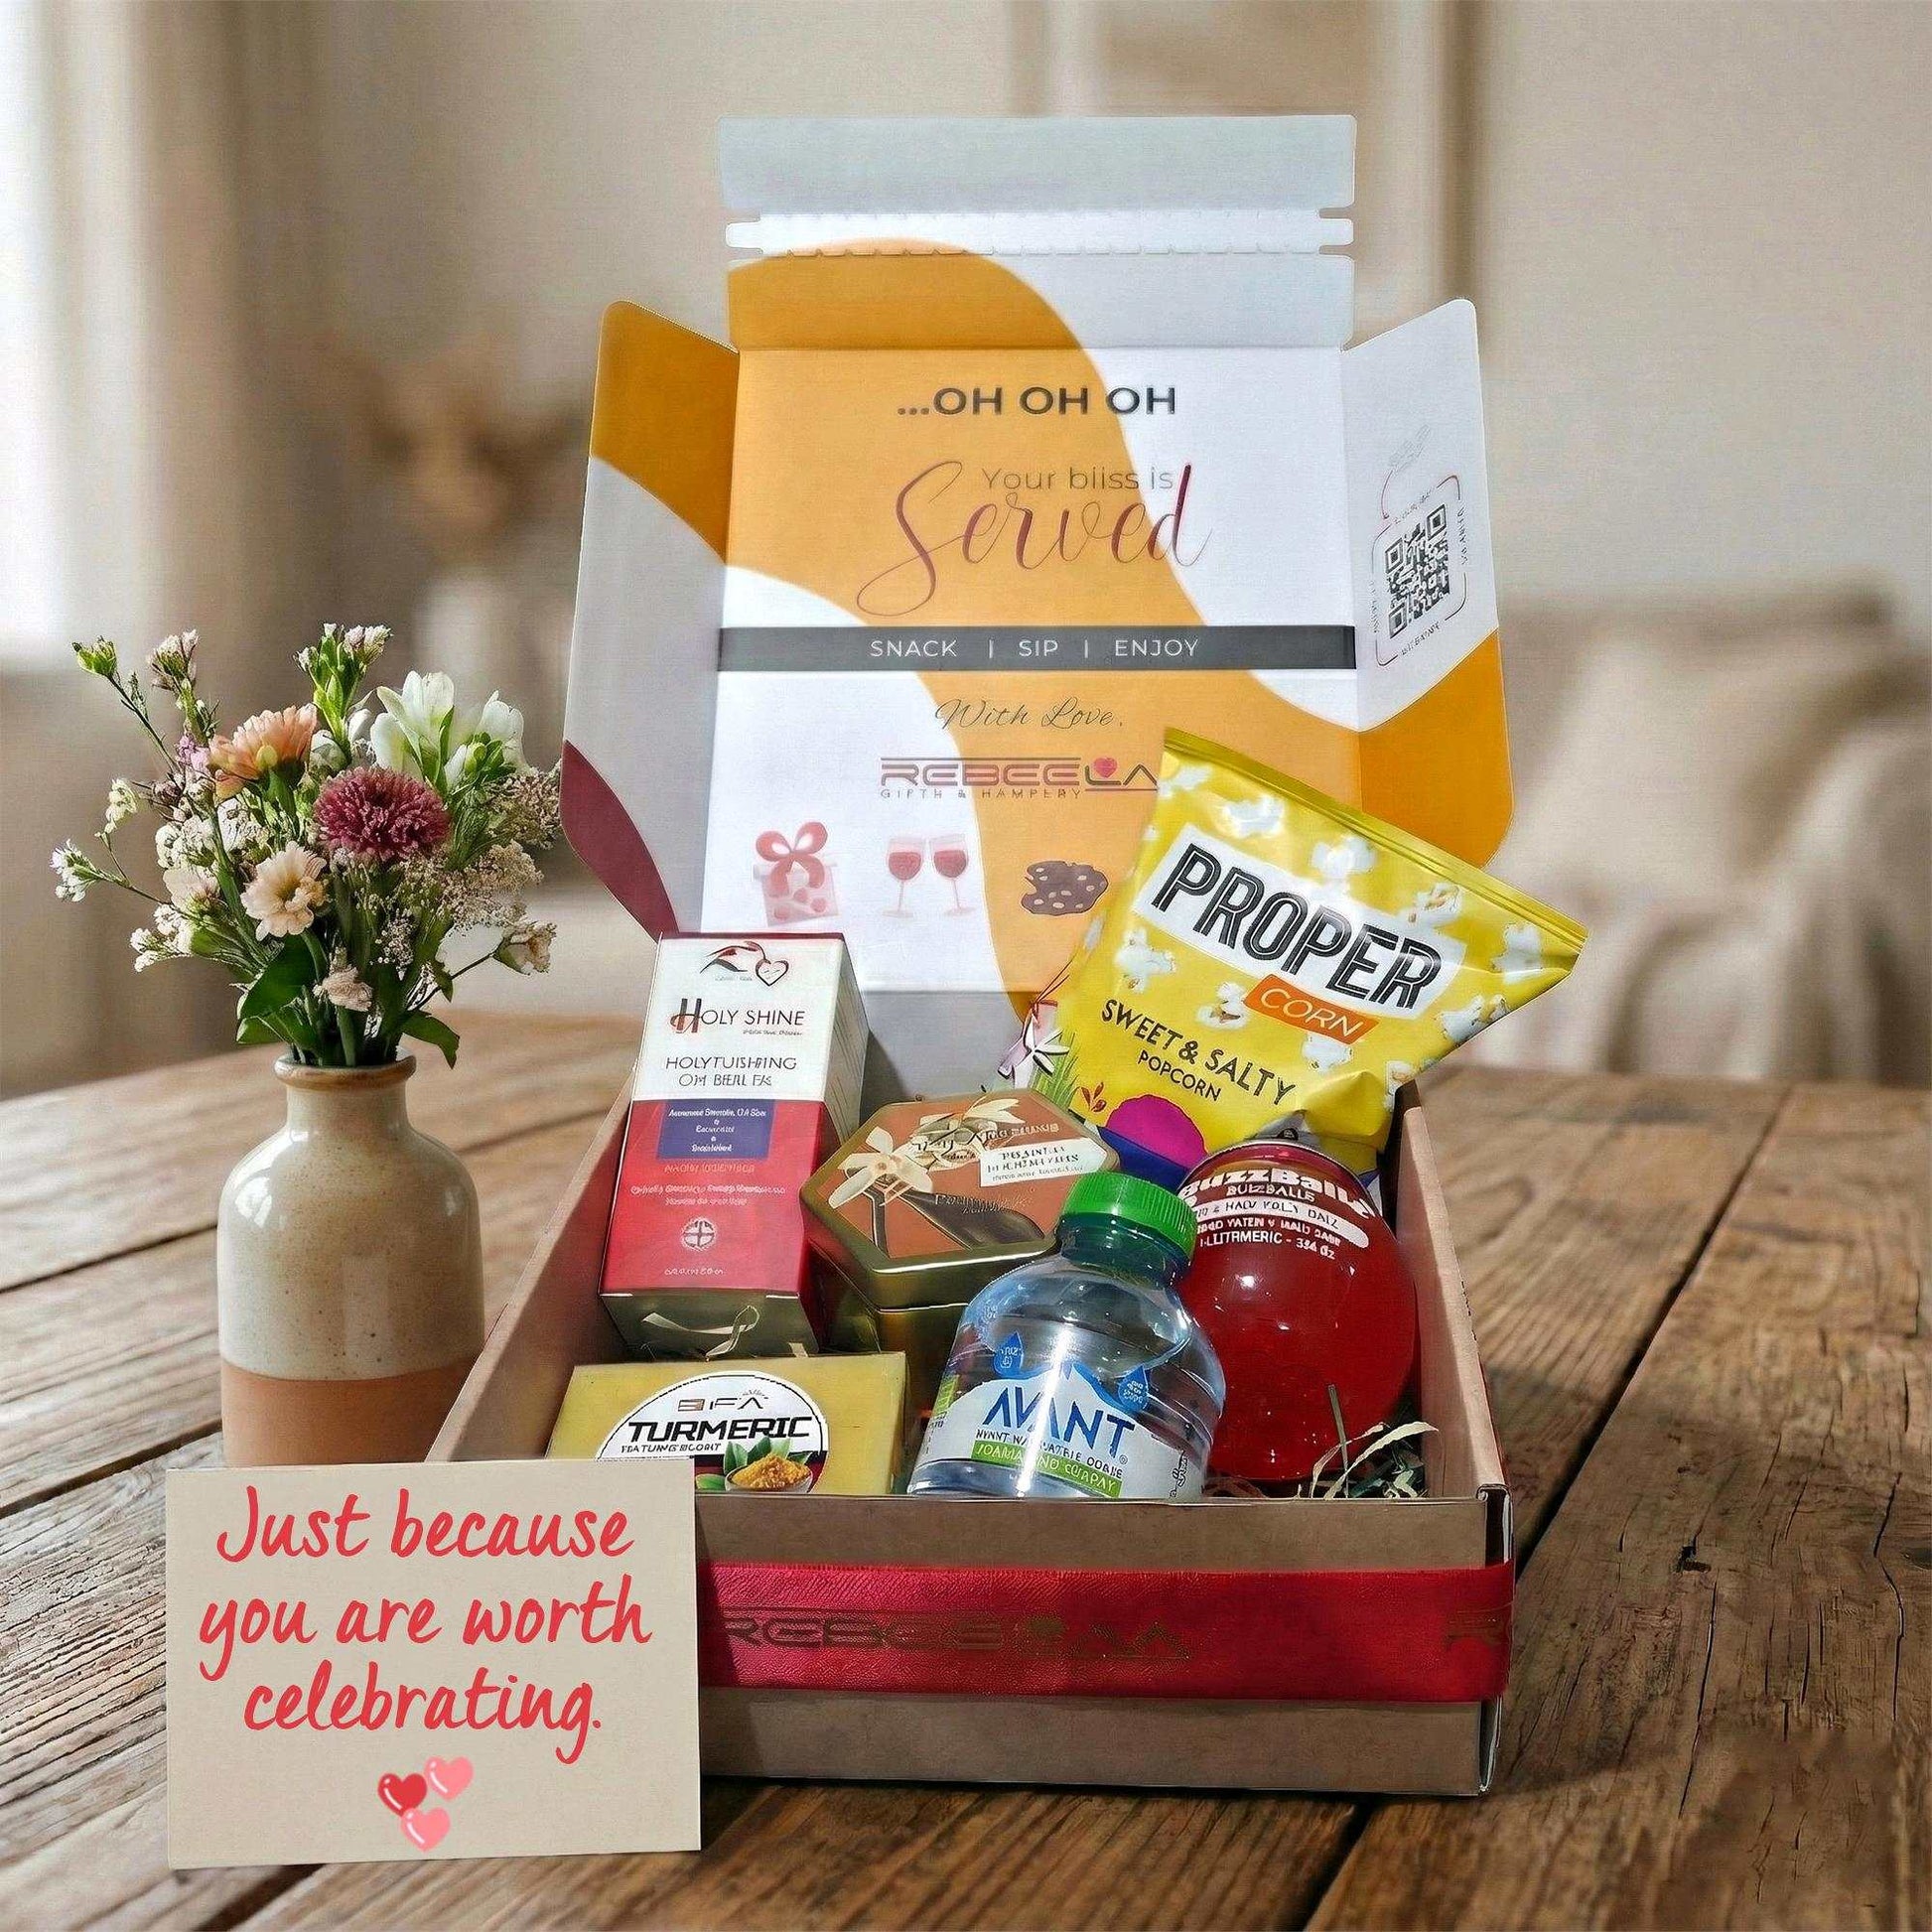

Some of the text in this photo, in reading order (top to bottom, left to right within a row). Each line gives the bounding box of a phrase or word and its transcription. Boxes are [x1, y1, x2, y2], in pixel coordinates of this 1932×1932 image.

[1019, 386, 1088, 415] OH
[1106, 386, 1176, 415] OH
[982, 467, 1056, 489] Your
[1151, 467, 1173, 489] is
[856, 460, 1213, 617] Served
[870, 638, 1198, 658] SNACK SIP ENJOY
[934, 697, 1031, 730] With
[1151, 842, 1442, 1010] PROPER
[670, 998, 806, 1034] HOLY SHINE
[1259, 987, 1364, 1038] CORN
[1101, 998, 1296, 1106] SWEET & SALTY
[1138, 1049, 1222, 1102] POPCORN
[628, 1417, 813, 1443] TURMERIC
[216, 1485, 635, 1563] Just because
[199, 1574, 653, 1681] you are worth
[242, 1659, 602, 1764] celebrating.
